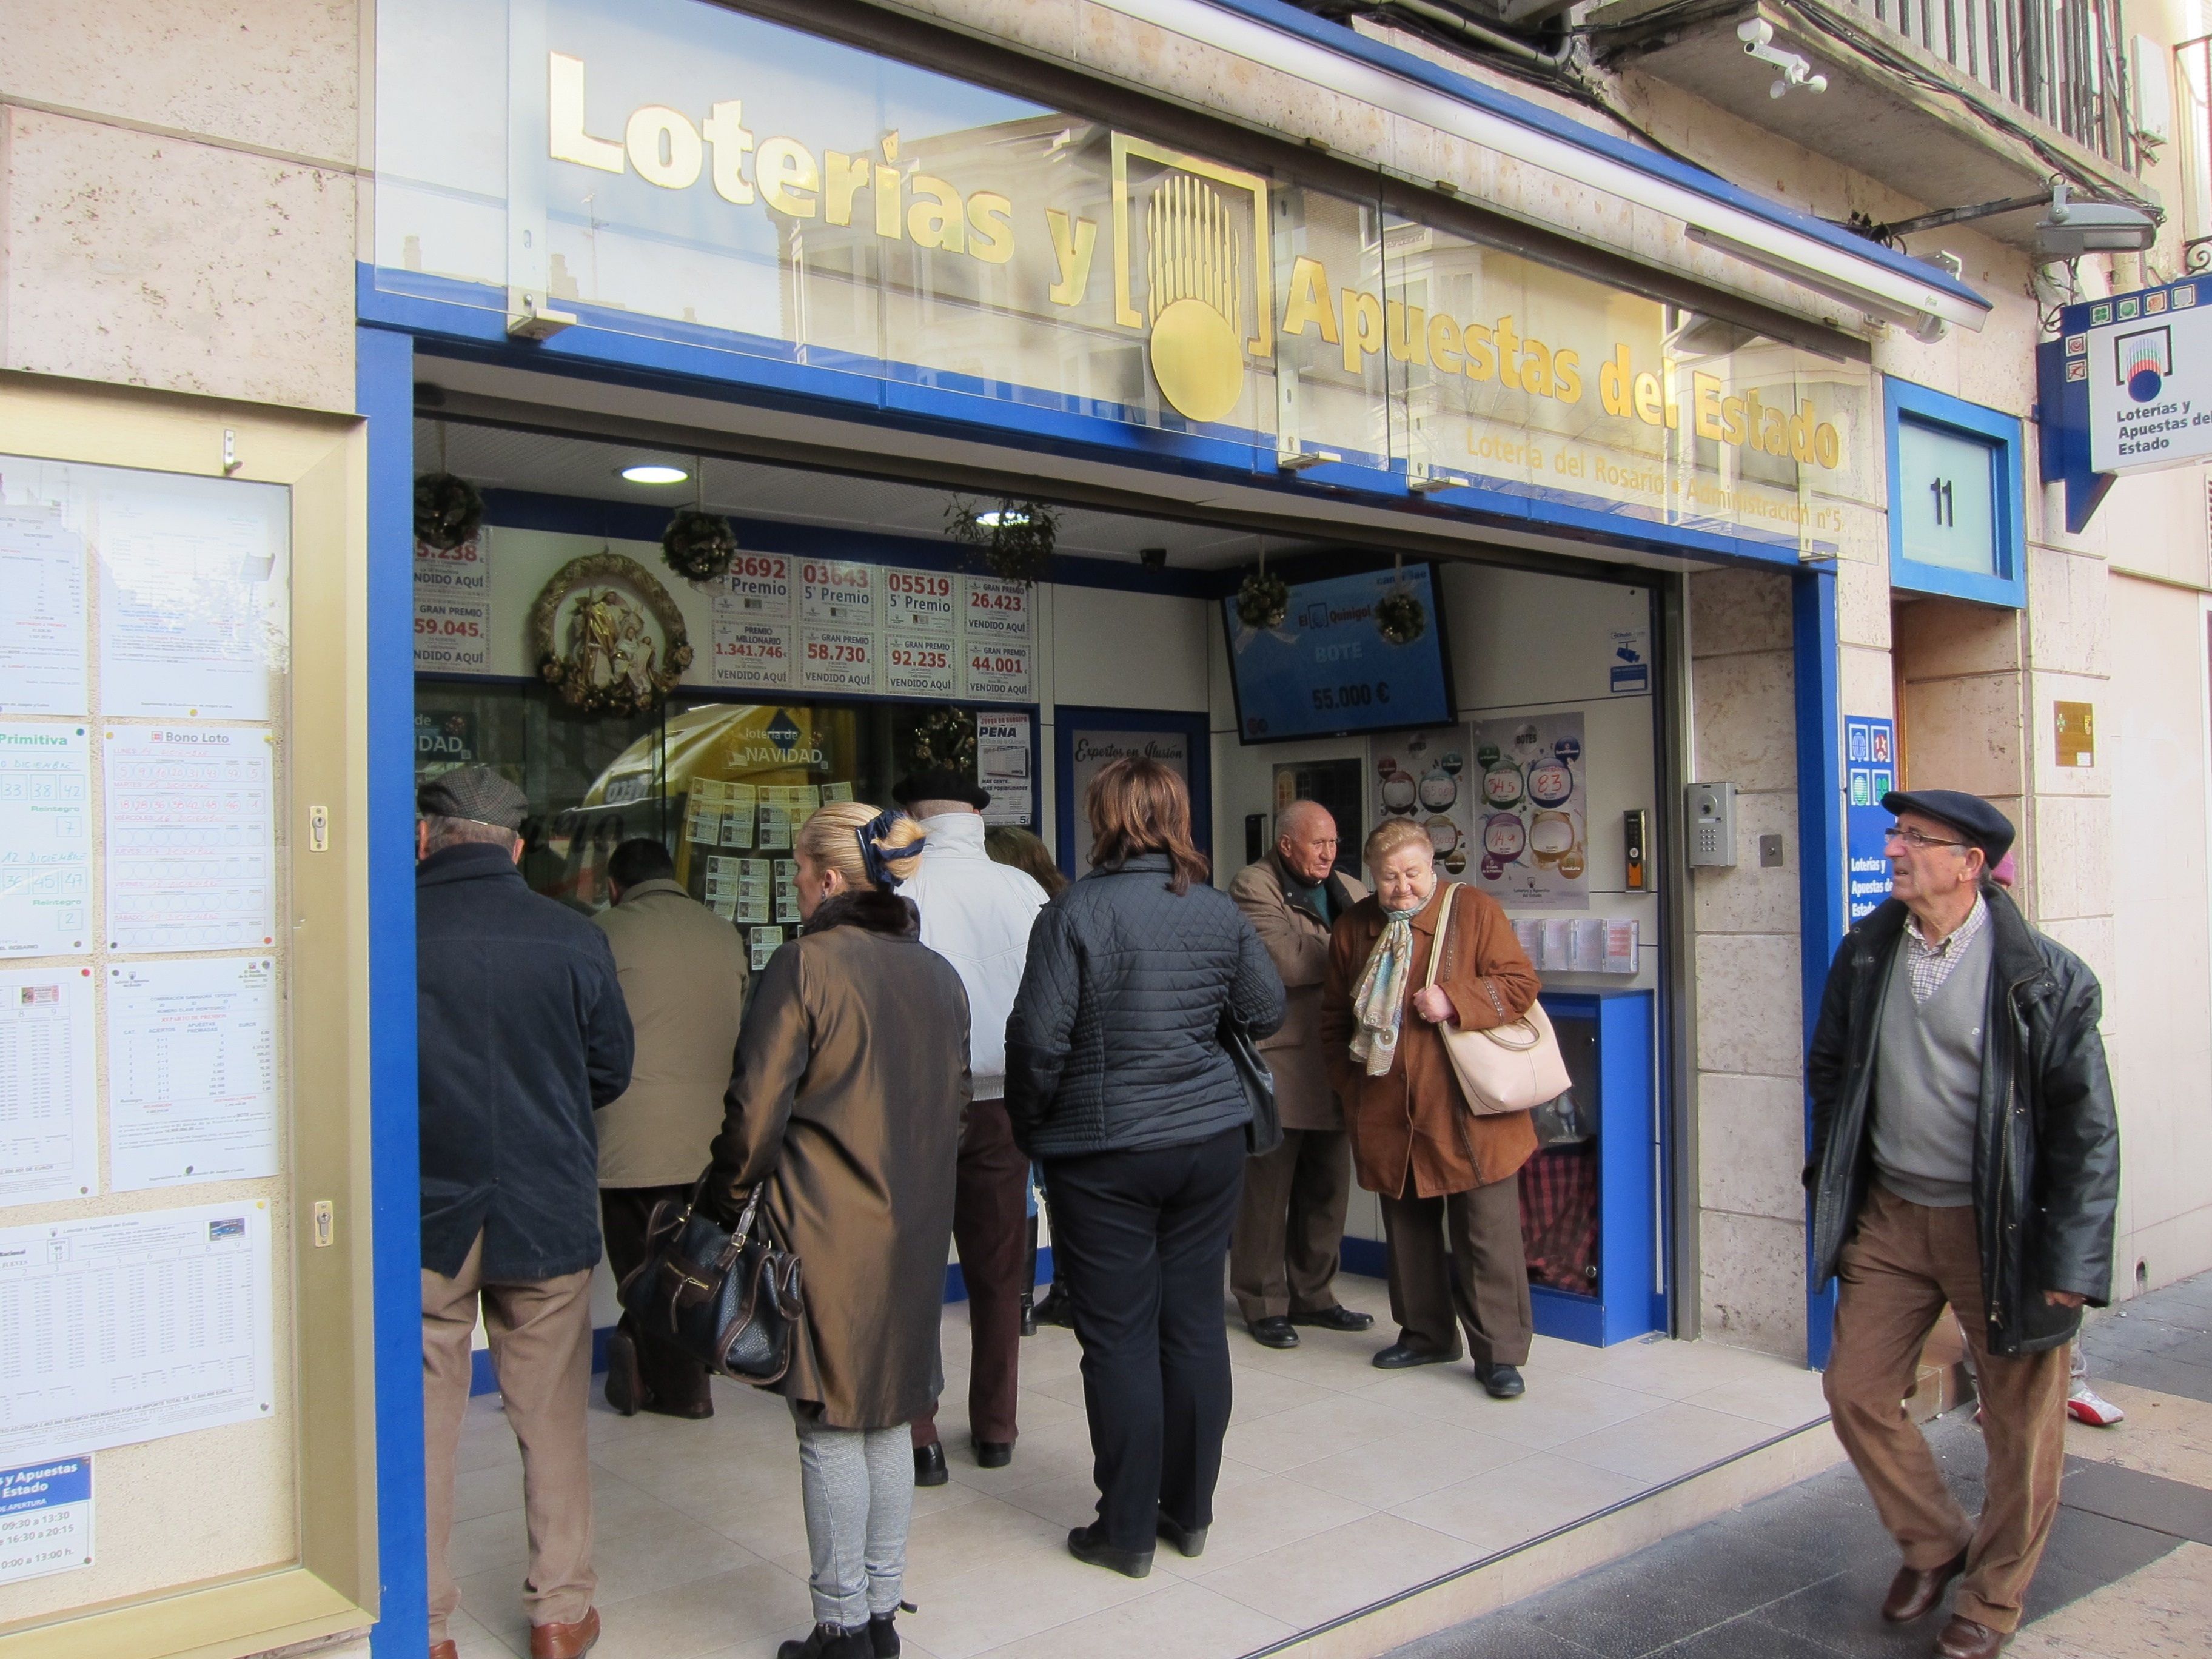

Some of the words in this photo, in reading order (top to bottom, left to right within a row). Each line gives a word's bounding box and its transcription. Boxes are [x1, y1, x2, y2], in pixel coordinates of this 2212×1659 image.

[549, 50, 1016, 264] Loterías
[1044, 206, 1098, 307] y
[1282, 254, 1582, 404] Apuestas
[1600, 343, 1678, 429] del
[1692, 370, 1839, 469] Estado
[2116, 402, 2179, 423] Loterías
[2181, 400, 2191, 415] y
[2117, 417, 2188, 441] Apuestas
[2191, 410, 2212, 426] del
[2117, 437, 2170, 456] Estado
[1554, 447, 1586, 479] del
[1595, 455, 1664, 495] Rosario
[1930, 477, 1954, 527] 11
[730, 556, 786, 580] 3692
[803, 563, 868, 589] 03643
[413, 572, 452, 585] NDIDO
[455, 575, 484, 589] AQUÍ
[731, 577, 787, 596] Premio
[888, 573, 950, 597] 05519
[983, 583, 1000, 592] GRAN
[821, 587, 870, 605] Premio
[905, 595, 951, 612] Premio
[971, 592, 1022, 612] 26.423
[419, 604, 446, 615] GRAN
[448, 606, 483, 618] PREMIO
[744, 626, 773, 635] PREMIO
[968, 619, 1004, 631] VENDIDO
[1006, 622, 1025, 633] AQUÍ
[736, 635, 782, 645] MILLONARIO
[821, 633, 842, 643] GRAN
[843, 635, 870, 645] PREMIO
[904, 640, 923, 649] GRAN
[925, 642, 950, 651] PREMIO
[413, 650, 452, 662] NDIDO
[455, 652, 484, 665] AQUÍ
[716, 642, 783, 659] 1.341.746
[807, 643, 866, 663] 58.730
[891, 649, 947, 669] 92.235
[984, 646, 1001, 655] GRAN
[1002, 648, 1027, 657] PREMIO
[1315, 640, 1363, 663] BOTE
[971, 655, 1023, 674] 44.001
[717, 669, 761, 681] VENDIDO
[763, 671, 787, 683] AQUÍ
[805, 672, 846, 683] VENDIDO
[848, 674, 870, 686] AQUÍ
[890, 677, 928, 688] VENDIDO
[930, 679, 951, 691] AQUÍ
[970, 683, 1006, 692] VENDIDO
[1007, 684, 1027, 695] AQUÍ
[1312, 683, 1372, 711] 55.000
[1376, 681, 1390, 704] €
[166, 732, 199, 743] Bono
[202, 732, 229, 744] Loto
[745, 728, 780, 739] lotería
[784, 729, 798, 740] de
[979, 724, 1017, 738] PEÑA
[1516, 733, 1538, 745] BOTES
[0, 734, 69, 746] Primitiva
[415, 736, 463, 752] IDAD
[745, 746, 823, 764] NAVIDAD
[1074, 738, 1124, 762] Expertos
[1126, 747, 1140, 757] en
[14, 759, 73, 769] DICIEMBRE
[4, 783, 22, 797] 33
[33, 783, 52, 798] 38
[64, 785, 81, 798] 42
[1537, 774, 1563, 793] 83
[64, 820, 75, 835] 7
[1, 851, 19, 863] 12
[27, 851, 88, 864] DICIEMBRE
[1851, 856, 1880, 872] Loterías
[1880, 859, 1886, 874] y
[33, 874, 56, 889] 45
[64, 873, 83, 888] 47
[1851, 880, 1885, 898] Apuestas
[1884, 877, 1894, 893] de
[1851, 900, 1877, 917] Estad
[65, 913, 76, 925] 2
[5, 1474, 15, 1487] y
[16, 1463, 78, 1483] Apuestas
[3, 1482, 49, 1498] Estado
[9, 1498, 47, 1510] APERTURA
[2, 1518, 32, 1532] 09:30
[42, 1510, 70, 1524] 13:30
[7, 1532, 35, 1544] 16:30
[45, 1523, 75, 1538] 20:15
[35, 1549, 62, 1563] 13:00
